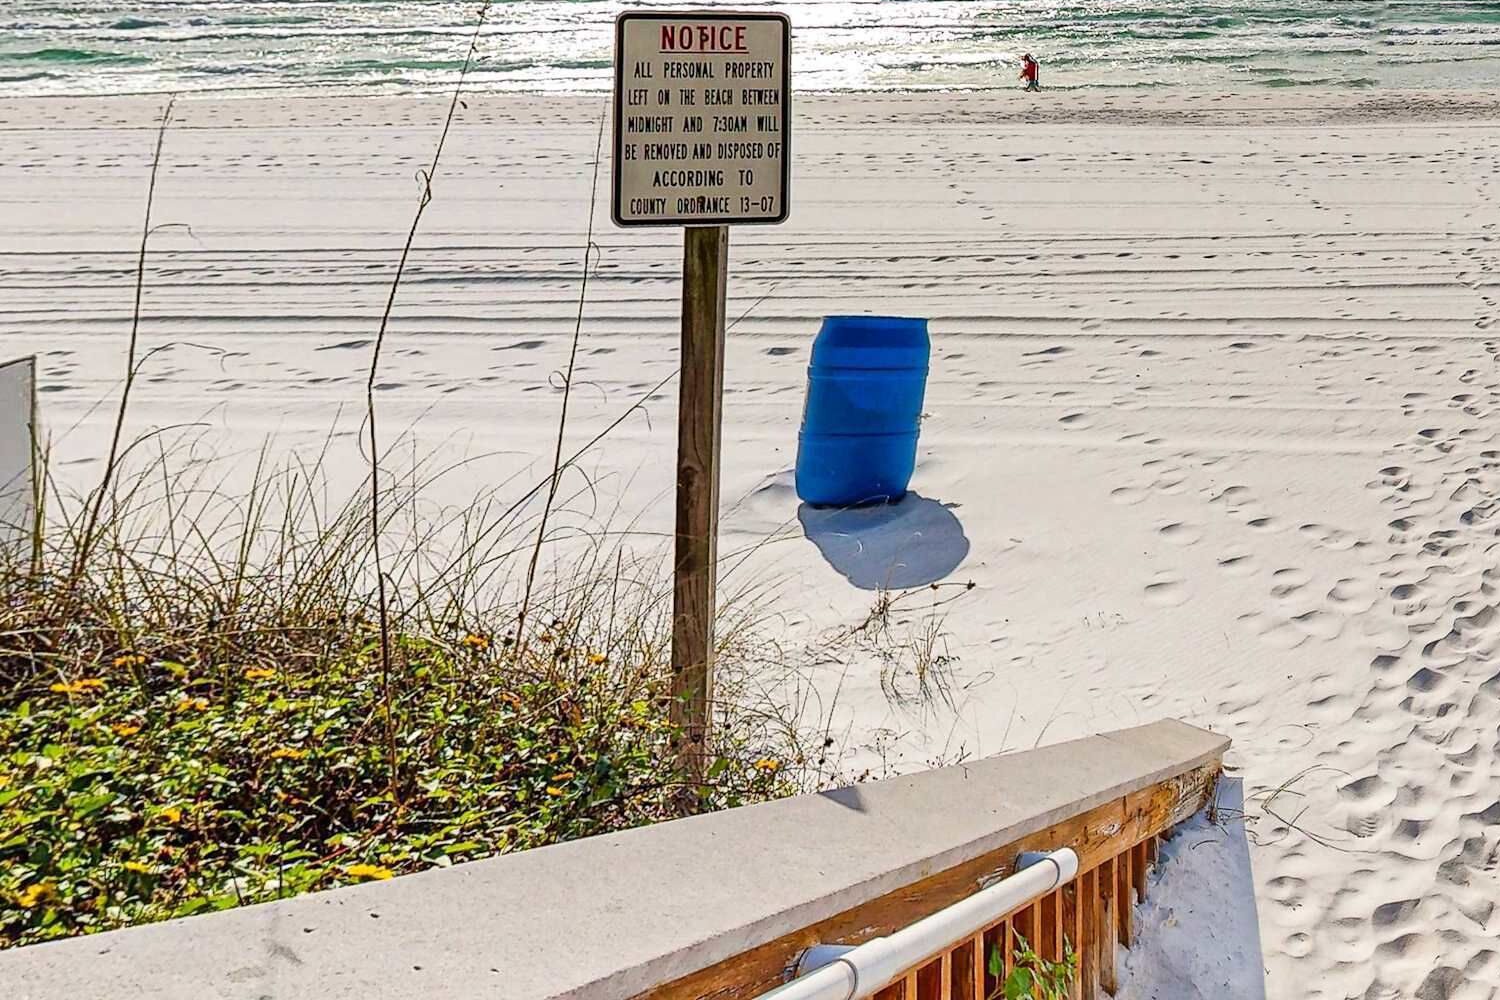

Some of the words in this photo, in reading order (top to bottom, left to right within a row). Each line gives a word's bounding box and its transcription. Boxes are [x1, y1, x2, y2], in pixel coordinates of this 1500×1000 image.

[661, 25, 747, 50] NOTICE
[634, 62, 653, 78] ALL
[663, 62, 714, 78] PERSONAL
[725, 62, 774, 78] PROPERTY
[628, 89, 648, 105] LEFT
[658, 89, 670, 105] ON
[680, 89, 695, 105] THE
[704, 89, 733, 105] BEACH
[742, 89, 779, 105] BETWEEN
[628, 116, 674, 133] MIDNIGHT
[683, 116, 702, 132] AND
[713, 116, 747, 132] 7:30AM
[757, 116, 779, 132] WILL
[625, 144, 637, 160] BE
[644, 144, 687, 160] REMOVED
[692, 144, 712, 159] AND
[718, 143, 763, 159] DISPOSED
[767, 143, 781, 159] OF
[653, 170, 724, 187] ACCORDING
[738, 169, 753, 185] TO
[630, 198, 666, 214] COUNTY
[740, 196, 774, 213] 13-07
